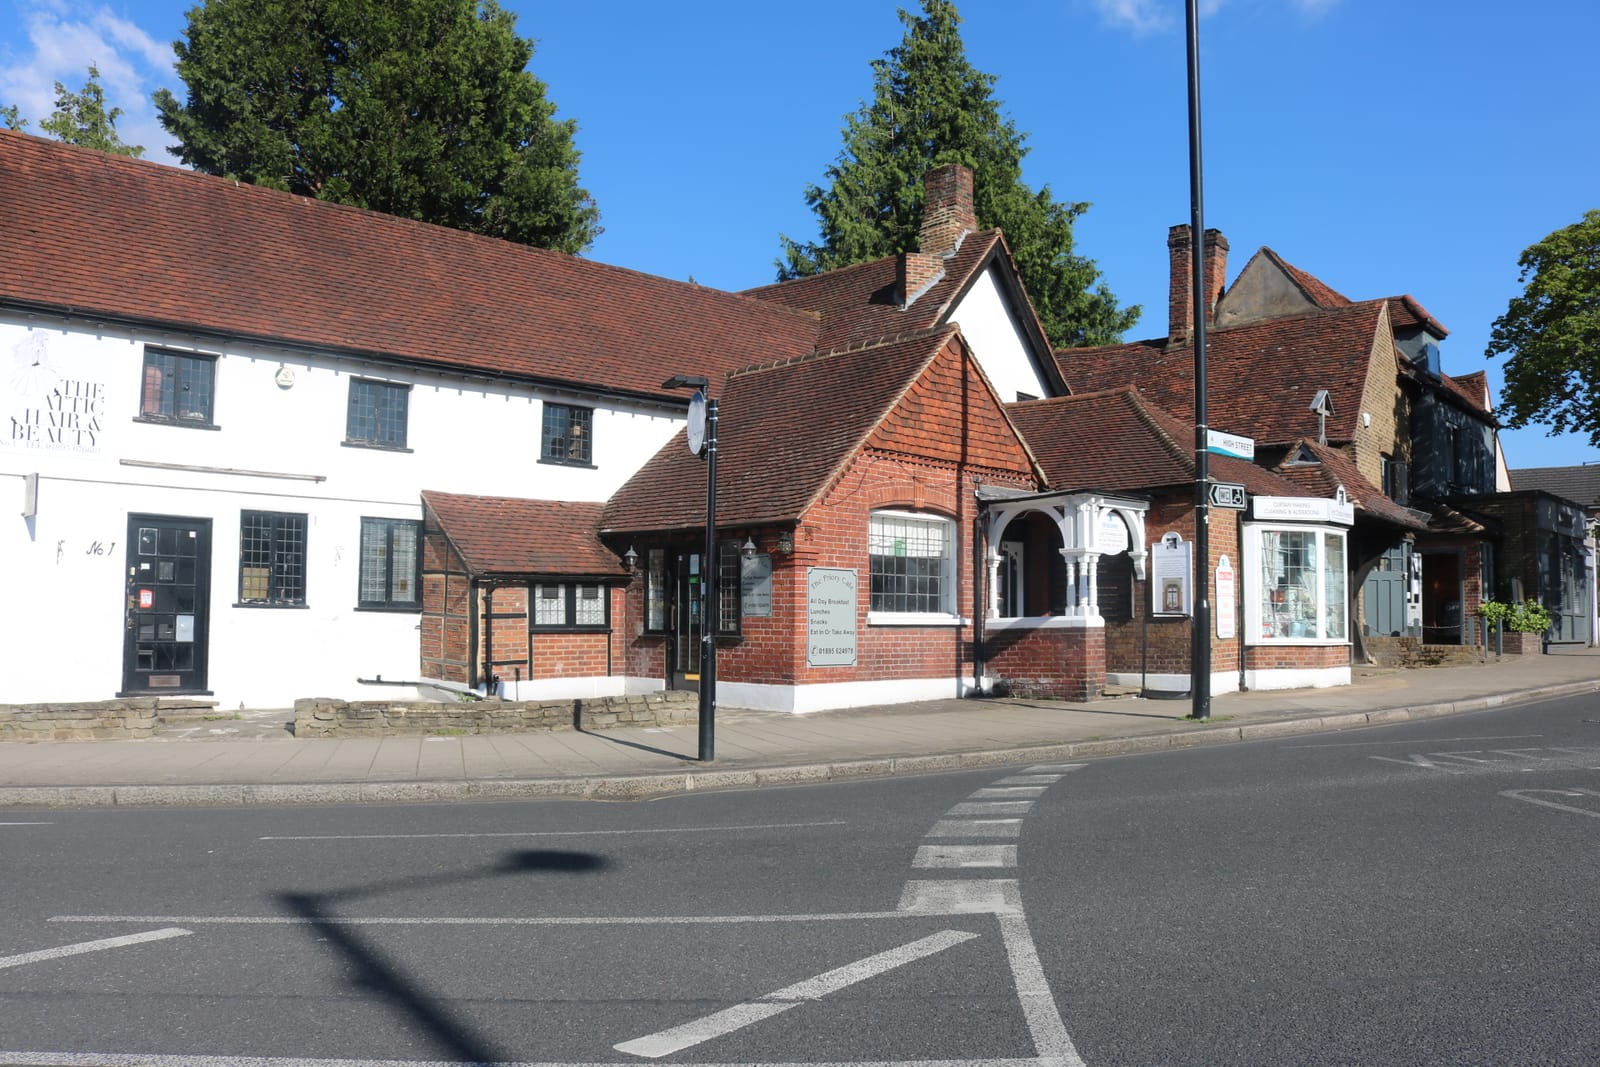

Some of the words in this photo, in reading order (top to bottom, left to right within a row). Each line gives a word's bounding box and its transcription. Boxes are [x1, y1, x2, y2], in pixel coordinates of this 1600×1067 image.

[60, 379, 104, 399] THE
[43, 388, 104, 415] ATTIC
[25, 408, 80, 429] HAIR
[88, 416, 101, 432] &
[11, 416, 98, 447] BEAUTY
[1223, 439, 1235, 449] HIGH
[1235, 441, 1253, 452] STREET
[1220, 490, 1230, 501] WC
[823, 574, 840, 583] Priory
[818, 598, 827, 606] Day
